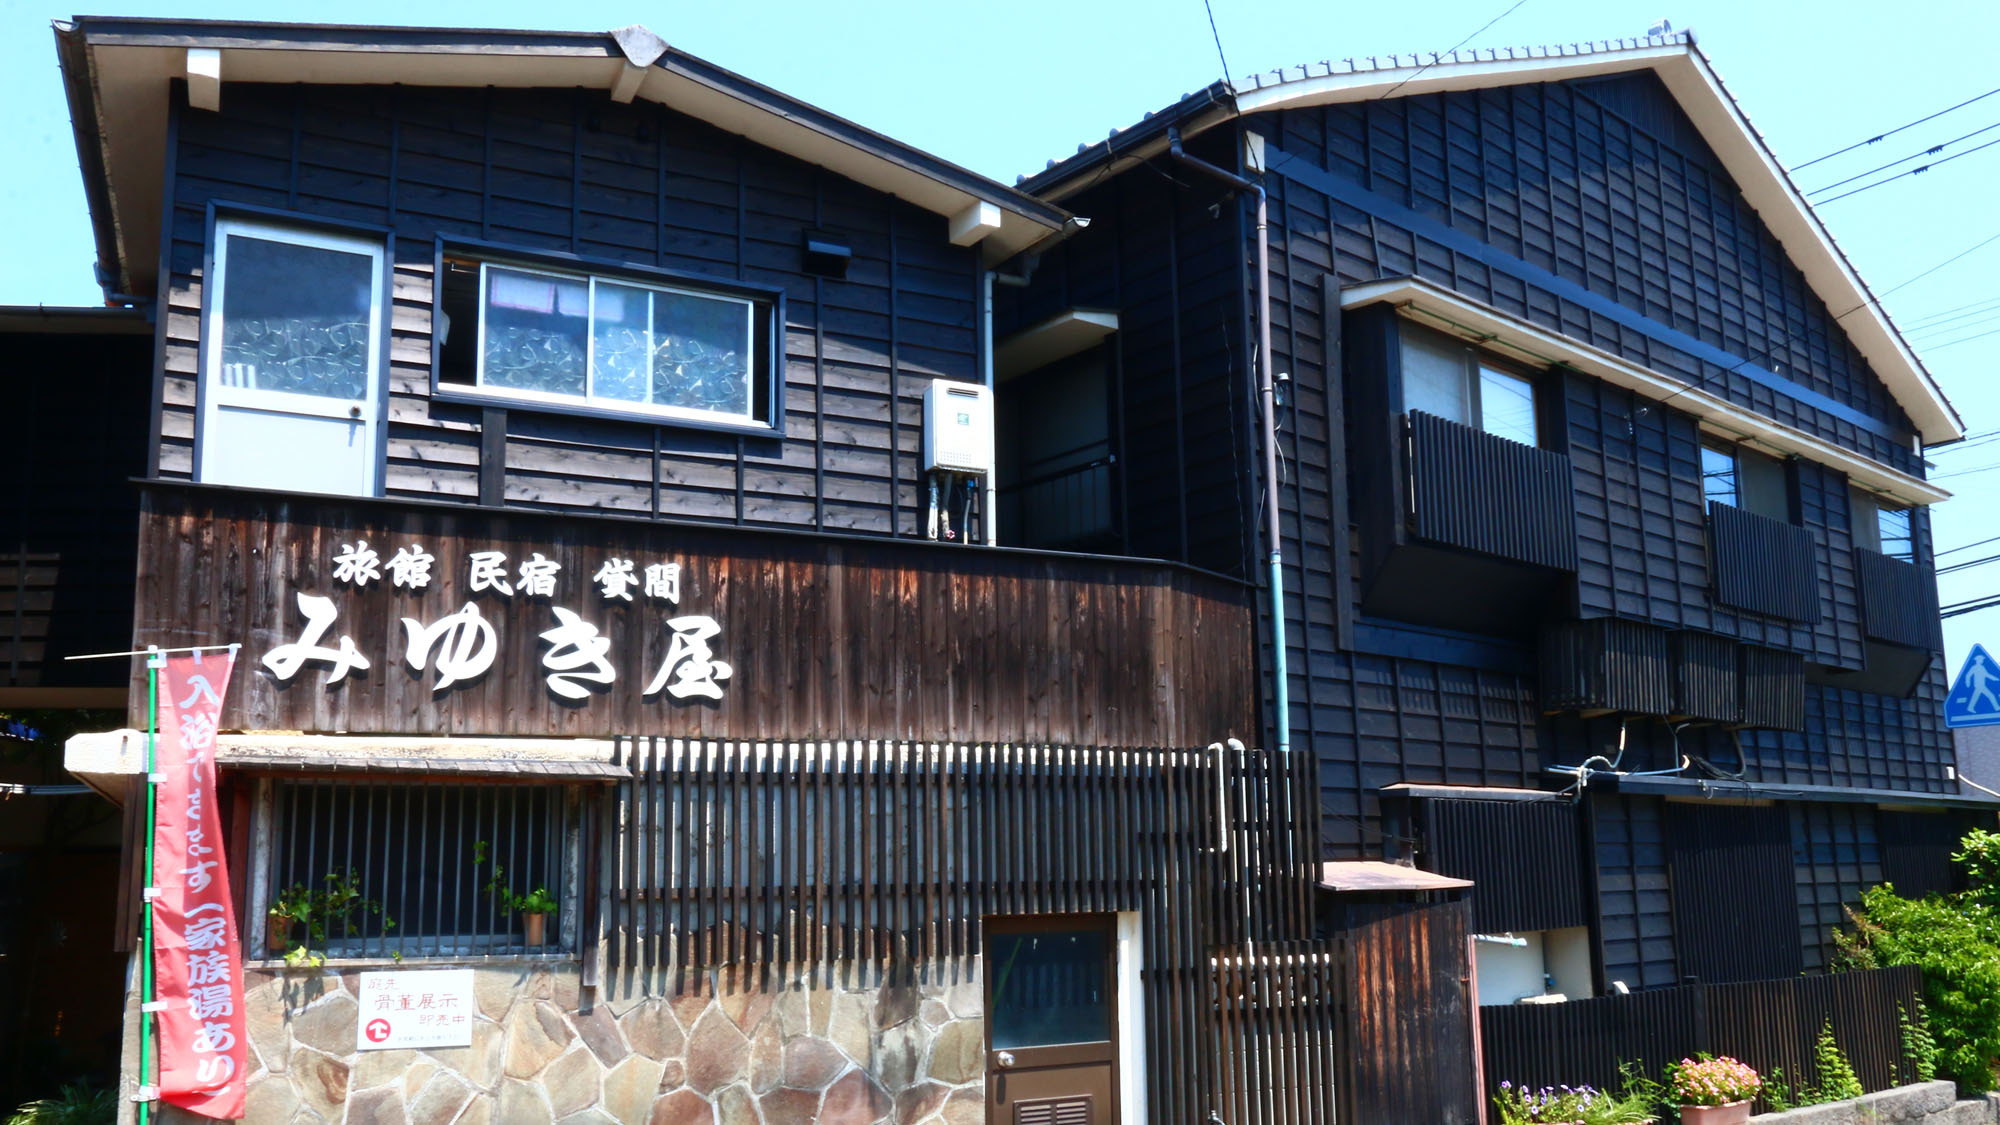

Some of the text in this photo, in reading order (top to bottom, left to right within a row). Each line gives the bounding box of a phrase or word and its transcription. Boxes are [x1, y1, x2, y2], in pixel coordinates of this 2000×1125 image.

[332, 540, 436, 591] 旅館
[468, 551, 562, 598] 民宿
[261, 591, 734, 700] みゆき屋
[375, 992, 459, 1011] 骨董展示
